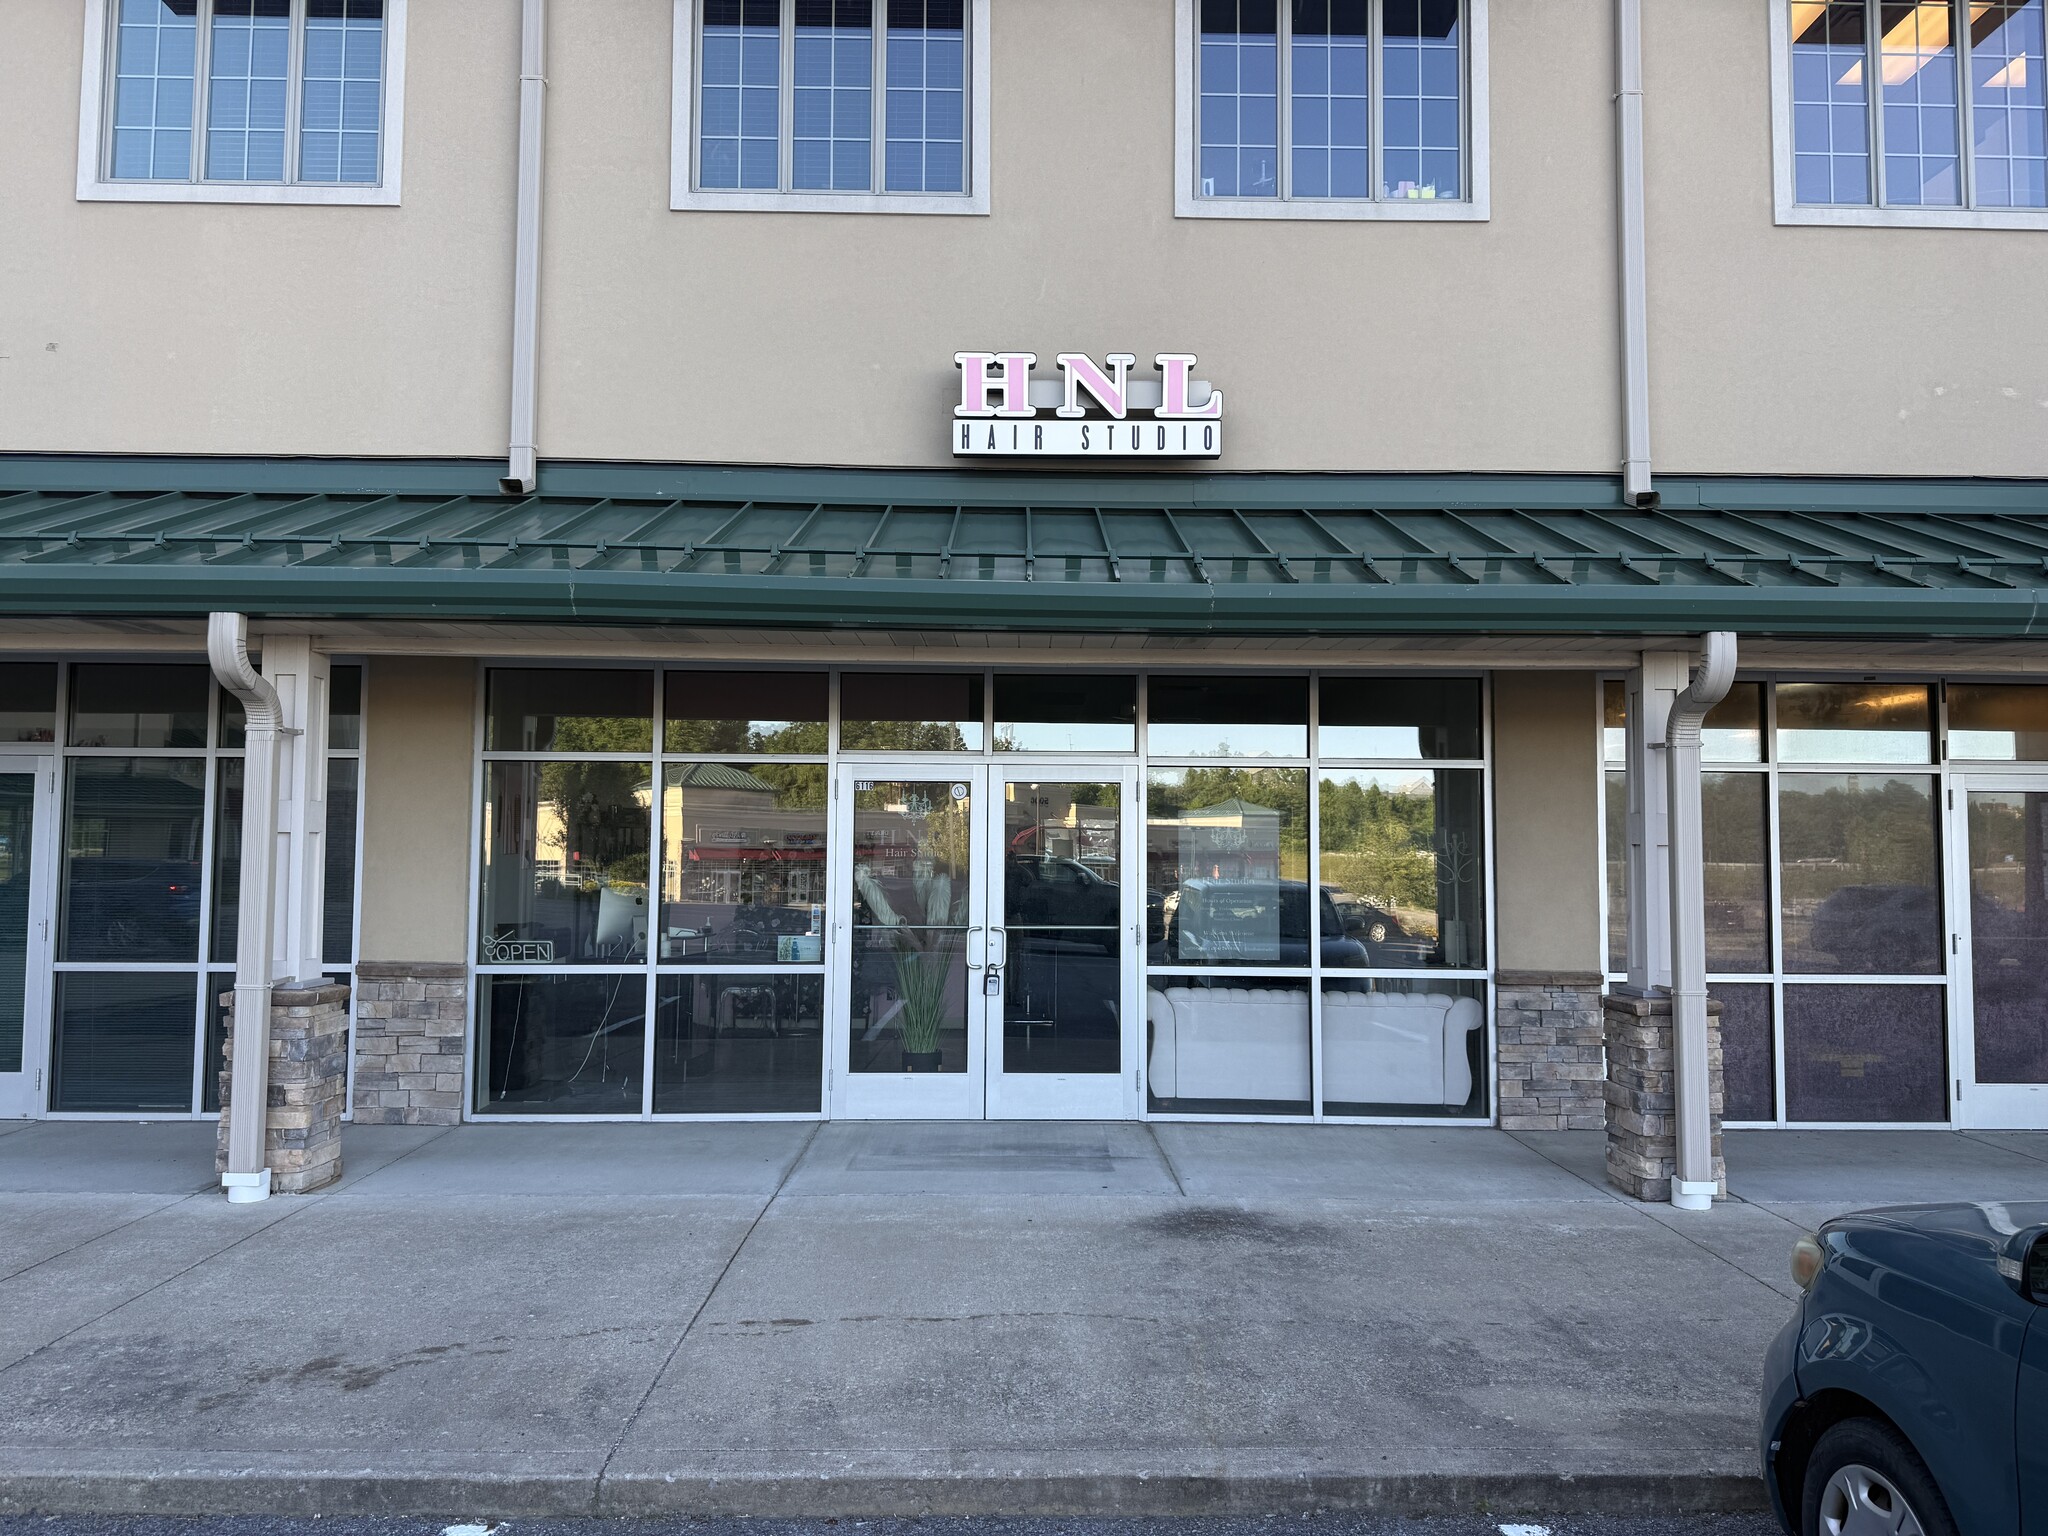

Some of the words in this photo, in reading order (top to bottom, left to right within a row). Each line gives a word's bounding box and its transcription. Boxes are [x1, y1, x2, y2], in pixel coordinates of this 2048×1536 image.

[953, 352, 1223, 419] HNL
[961, 423, 1043, 450] HAIR
[1081, 424, 1213, 451] STUDIO
[855, 782, 874, 791] 6116
[885, 848, 908, 857] Hair
[1226, 876, 1255, 885] Studio
[496, 944, 550, 961] OPEN
